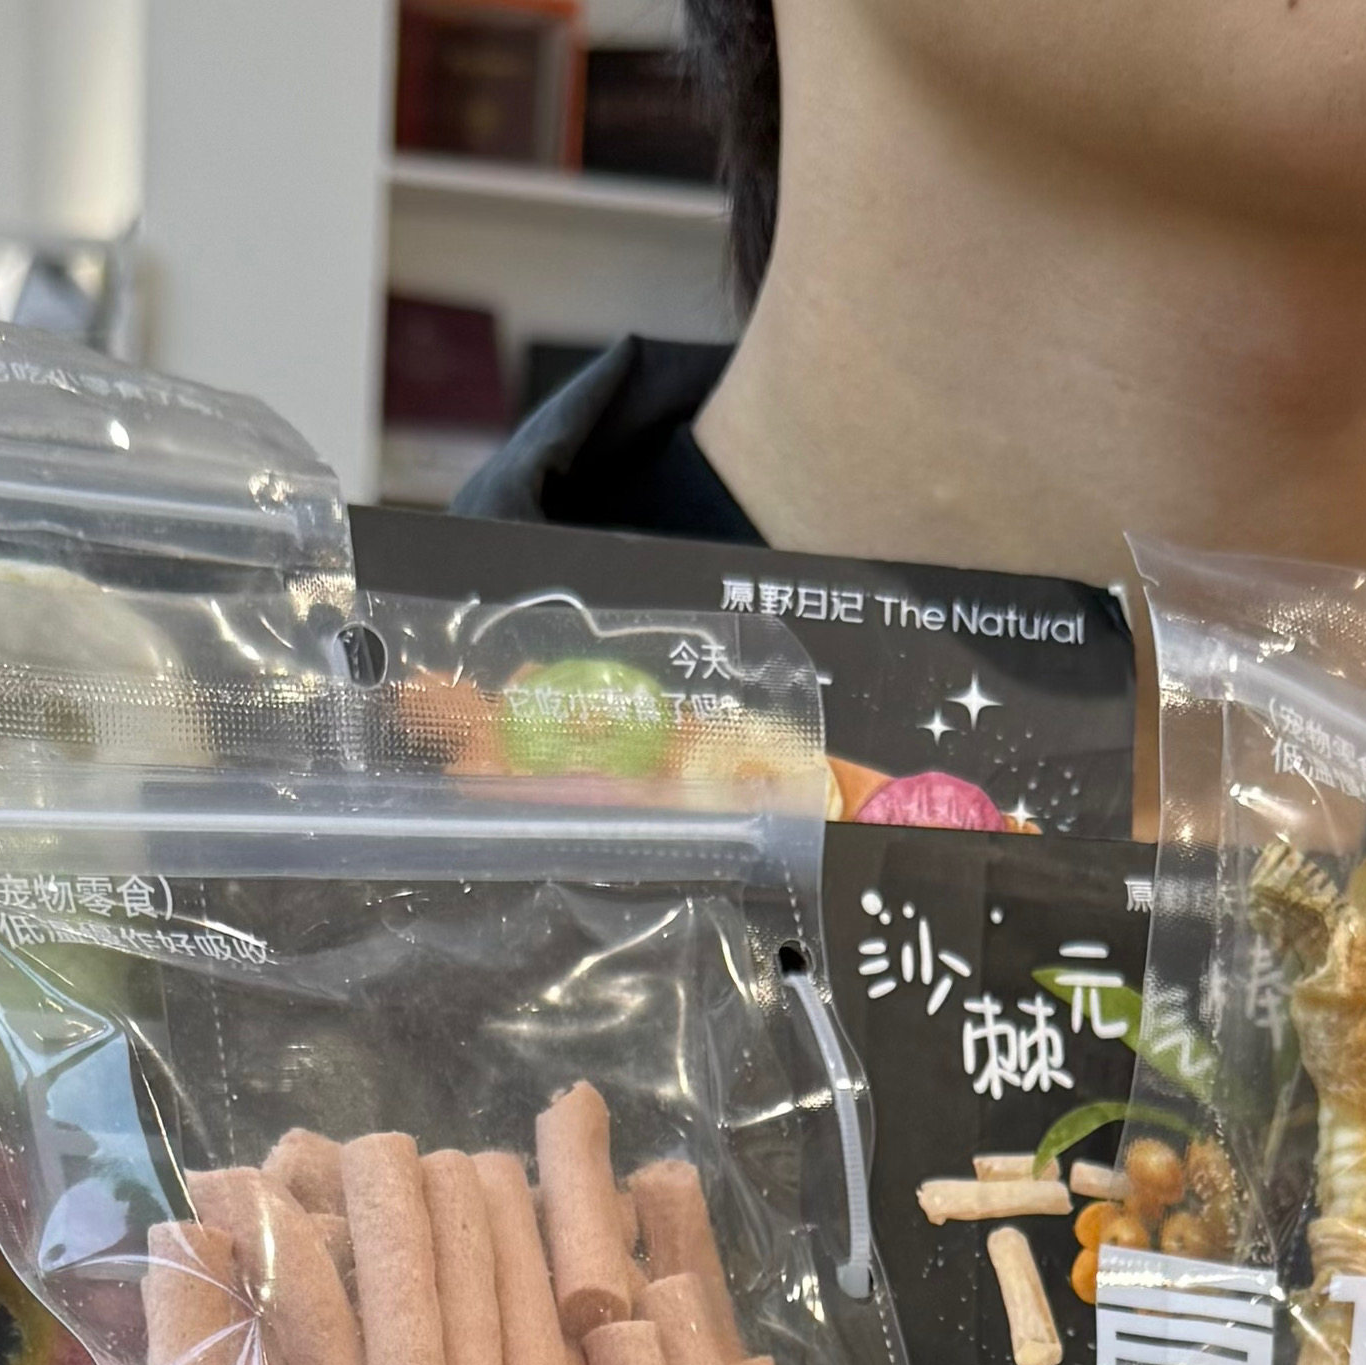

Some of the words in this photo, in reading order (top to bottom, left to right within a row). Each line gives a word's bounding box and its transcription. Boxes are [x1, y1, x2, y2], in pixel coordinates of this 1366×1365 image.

[720, 578, 866, 624] 原野日记
[874, 594, 948, 631] The
[950, 600, 1087, 646] Natural
[669, 639, 732, 680] 今天
